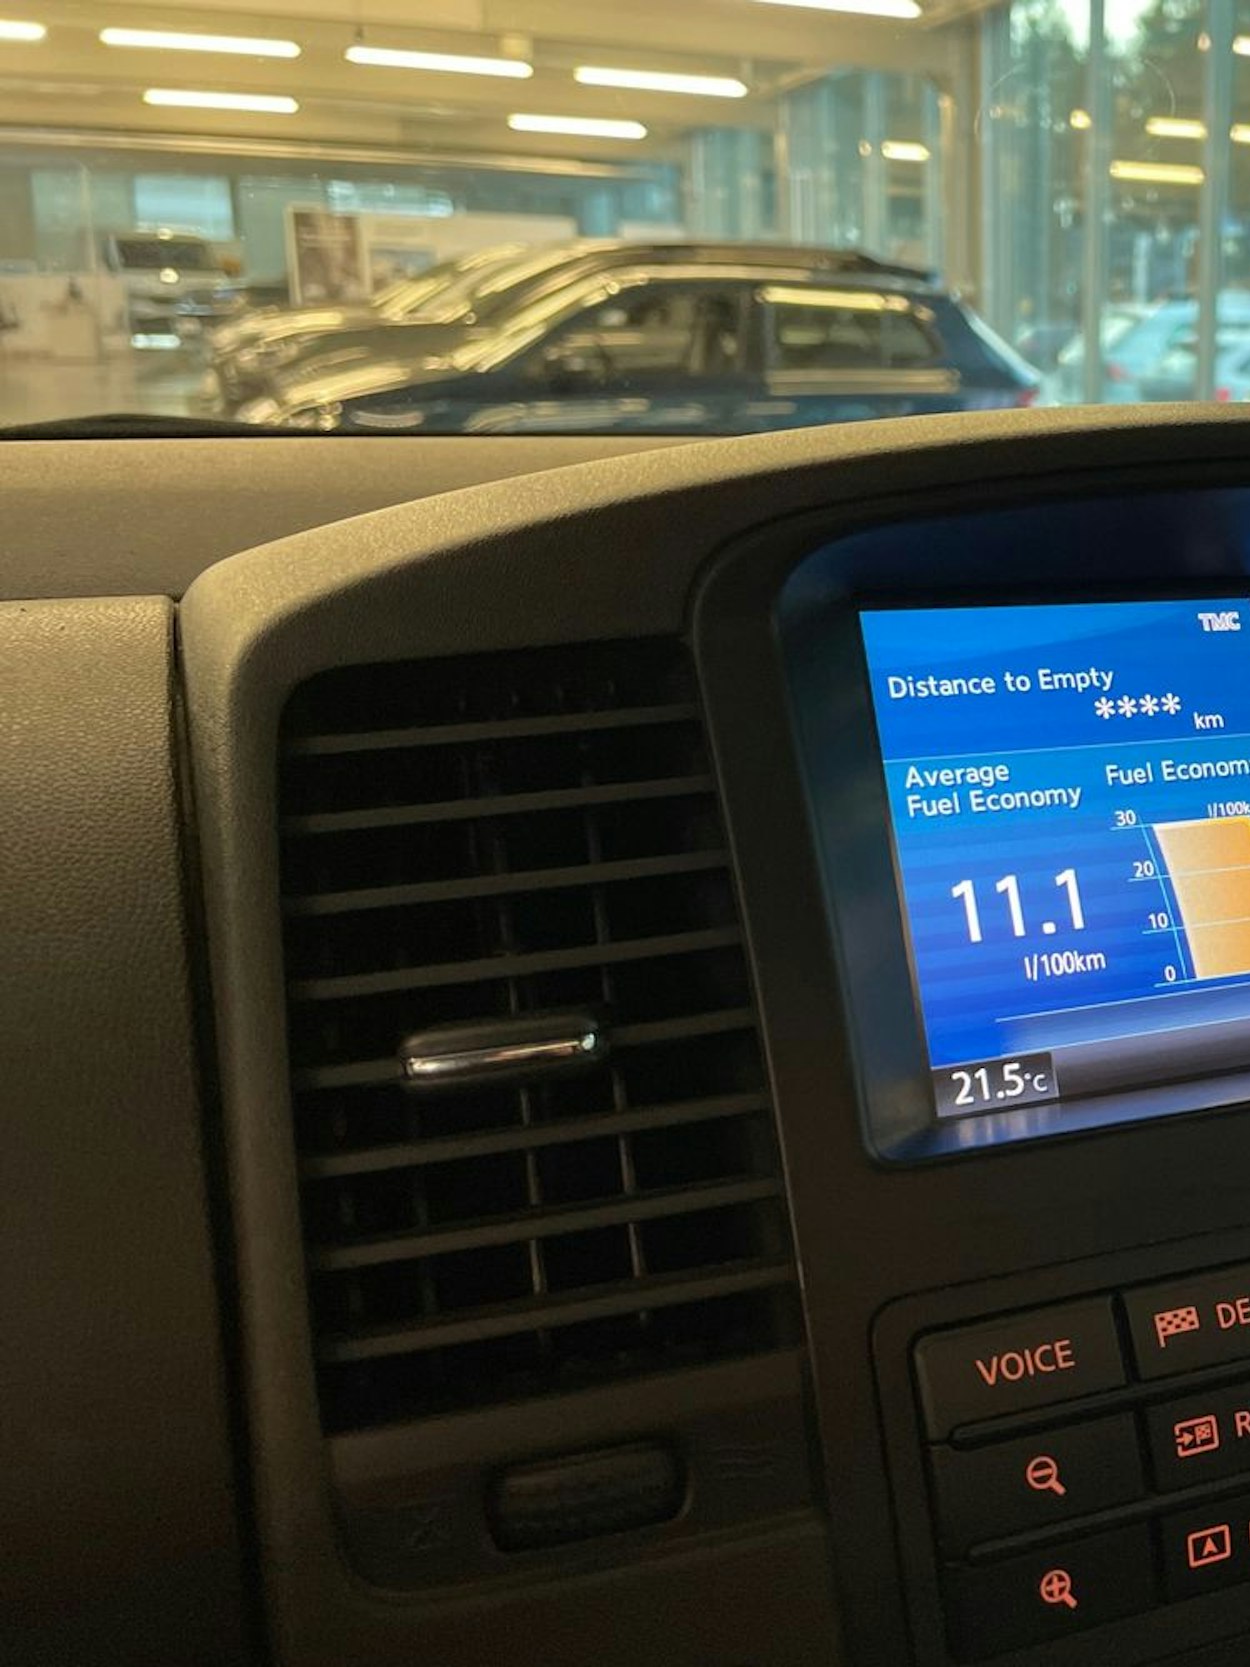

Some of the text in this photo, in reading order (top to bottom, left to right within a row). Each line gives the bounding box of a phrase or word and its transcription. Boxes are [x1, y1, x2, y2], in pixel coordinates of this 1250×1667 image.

[1197, 611, 1242, 632] TMC
[887, 667, 1115, 699] Distance to Empty
[1193, 711, 1225, 730] km
[904, 764, 1010, 790] Average
[1105, 761, 1154, 787] Fuel
[906, 785, 1082, 818] Fuel Economy
[1114, 810, 1137, 827] 30
[1132, 861, 1155, 878] 20
[950, 868, 1086, 944] 11.1
[1147, 912, 1169, 930] 10
[1023, 949, 1107, 982] l/100km
[1164, 965, 1177, 982] 0
[975, 1339, 1076, 1386] VOICE
